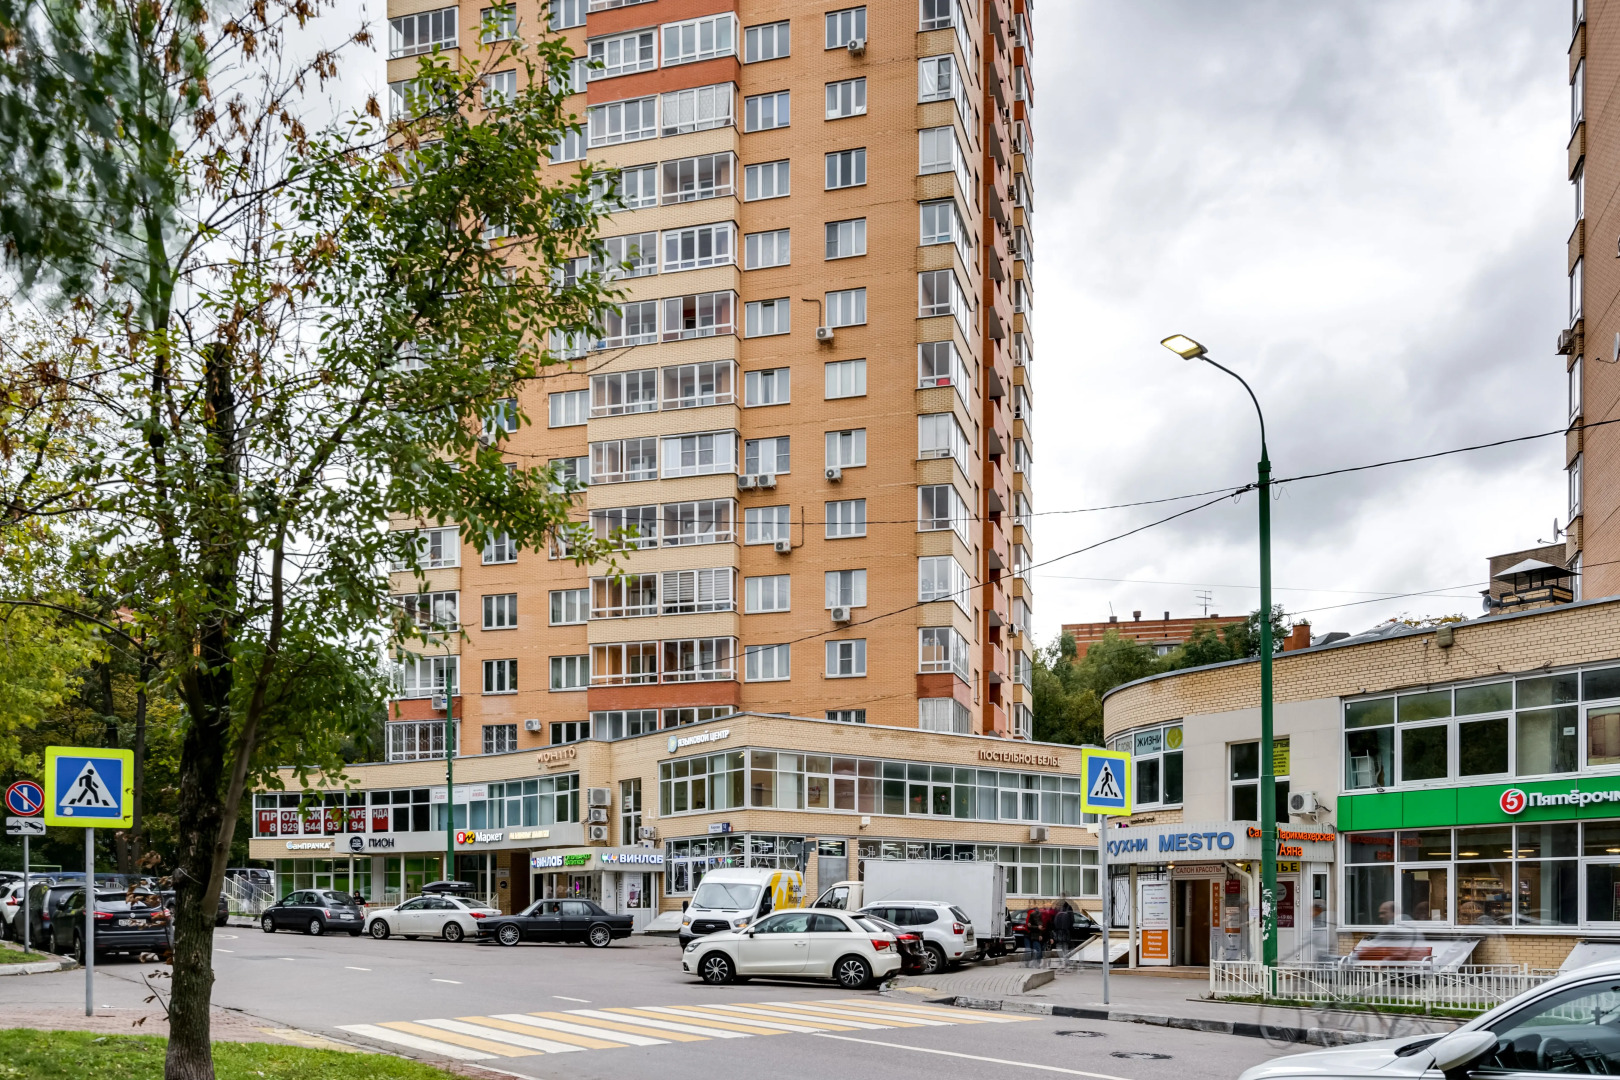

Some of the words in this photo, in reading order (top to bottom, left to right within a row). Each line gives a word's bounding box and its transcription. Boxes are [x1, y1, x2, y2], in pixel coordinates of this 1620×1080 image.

[678, 730, 709, 747] ЯЗЫКОВОЙ
[710, 730, 730, 742] ЦЕНТР
[1137, 735, 1161, 747] ЖИЗНИ
[979, 750, 1035, 764] ПОСТЕЛЬНОЕ
[270, 823, 277, 832] 8
[282, 823, 298, 832] 929
[305, 822, 321, 831] 544
[327, 821, 340, 831] 93
[351, 821, 364, 830] 94
[368, 838, 394, 848] ПИОН
[475, 832, 504, 843] Маркет
[1158, 832, 1235, 853] MESTO
[1279, 843, 1303, 857] Аяна
